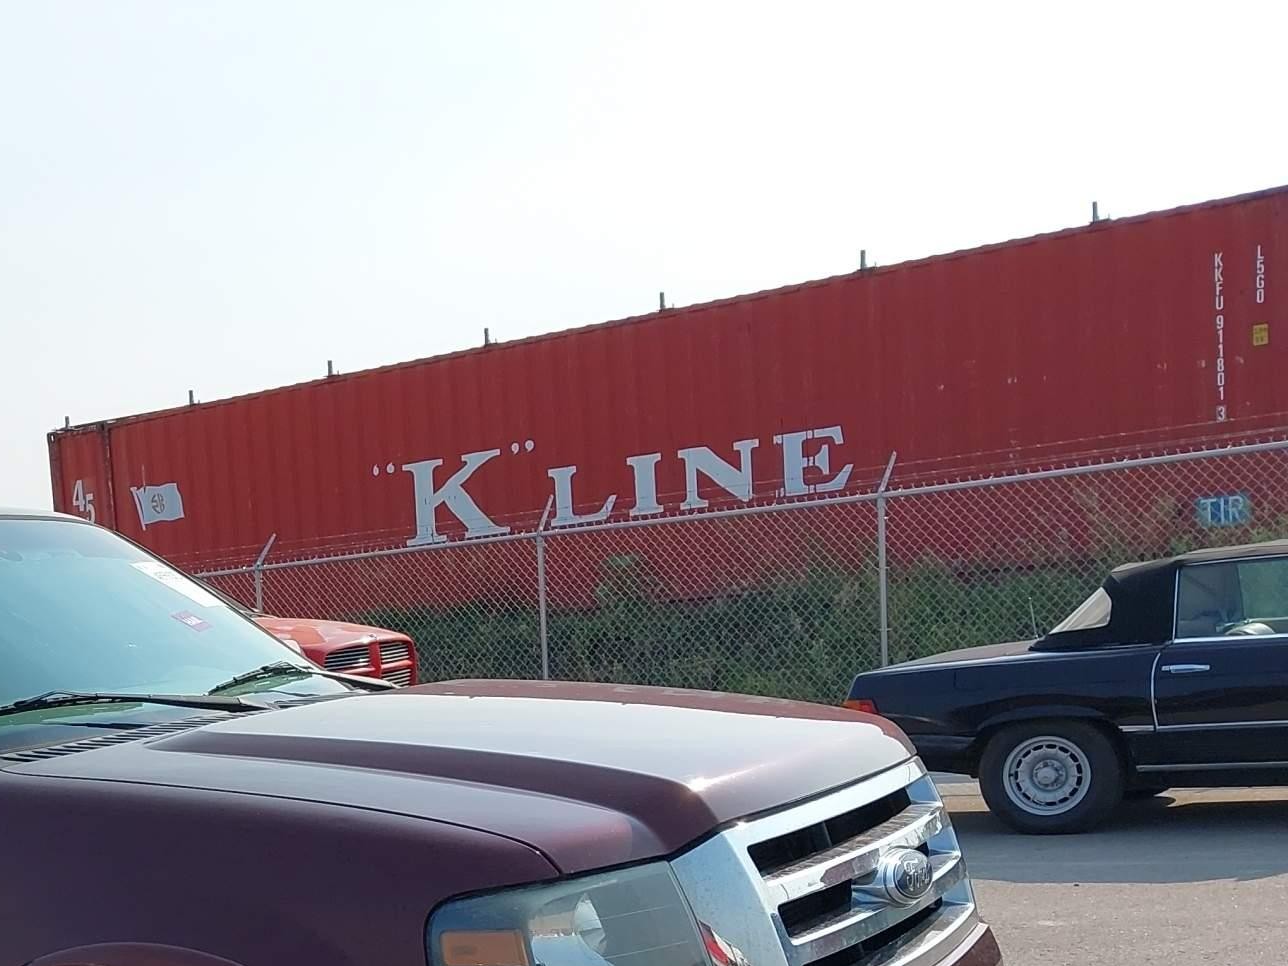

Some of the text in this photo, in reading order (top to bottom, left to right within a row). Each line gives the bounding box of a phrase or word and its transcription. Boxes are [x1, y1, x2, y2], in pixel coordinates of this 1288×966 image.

[1214, 252, 1226, 421] KKFU 911801 3
[72, 479, 96, 524] 45
[547, 425, 855, 527] LINE
[1199, 495, 1244, 524] TIR
